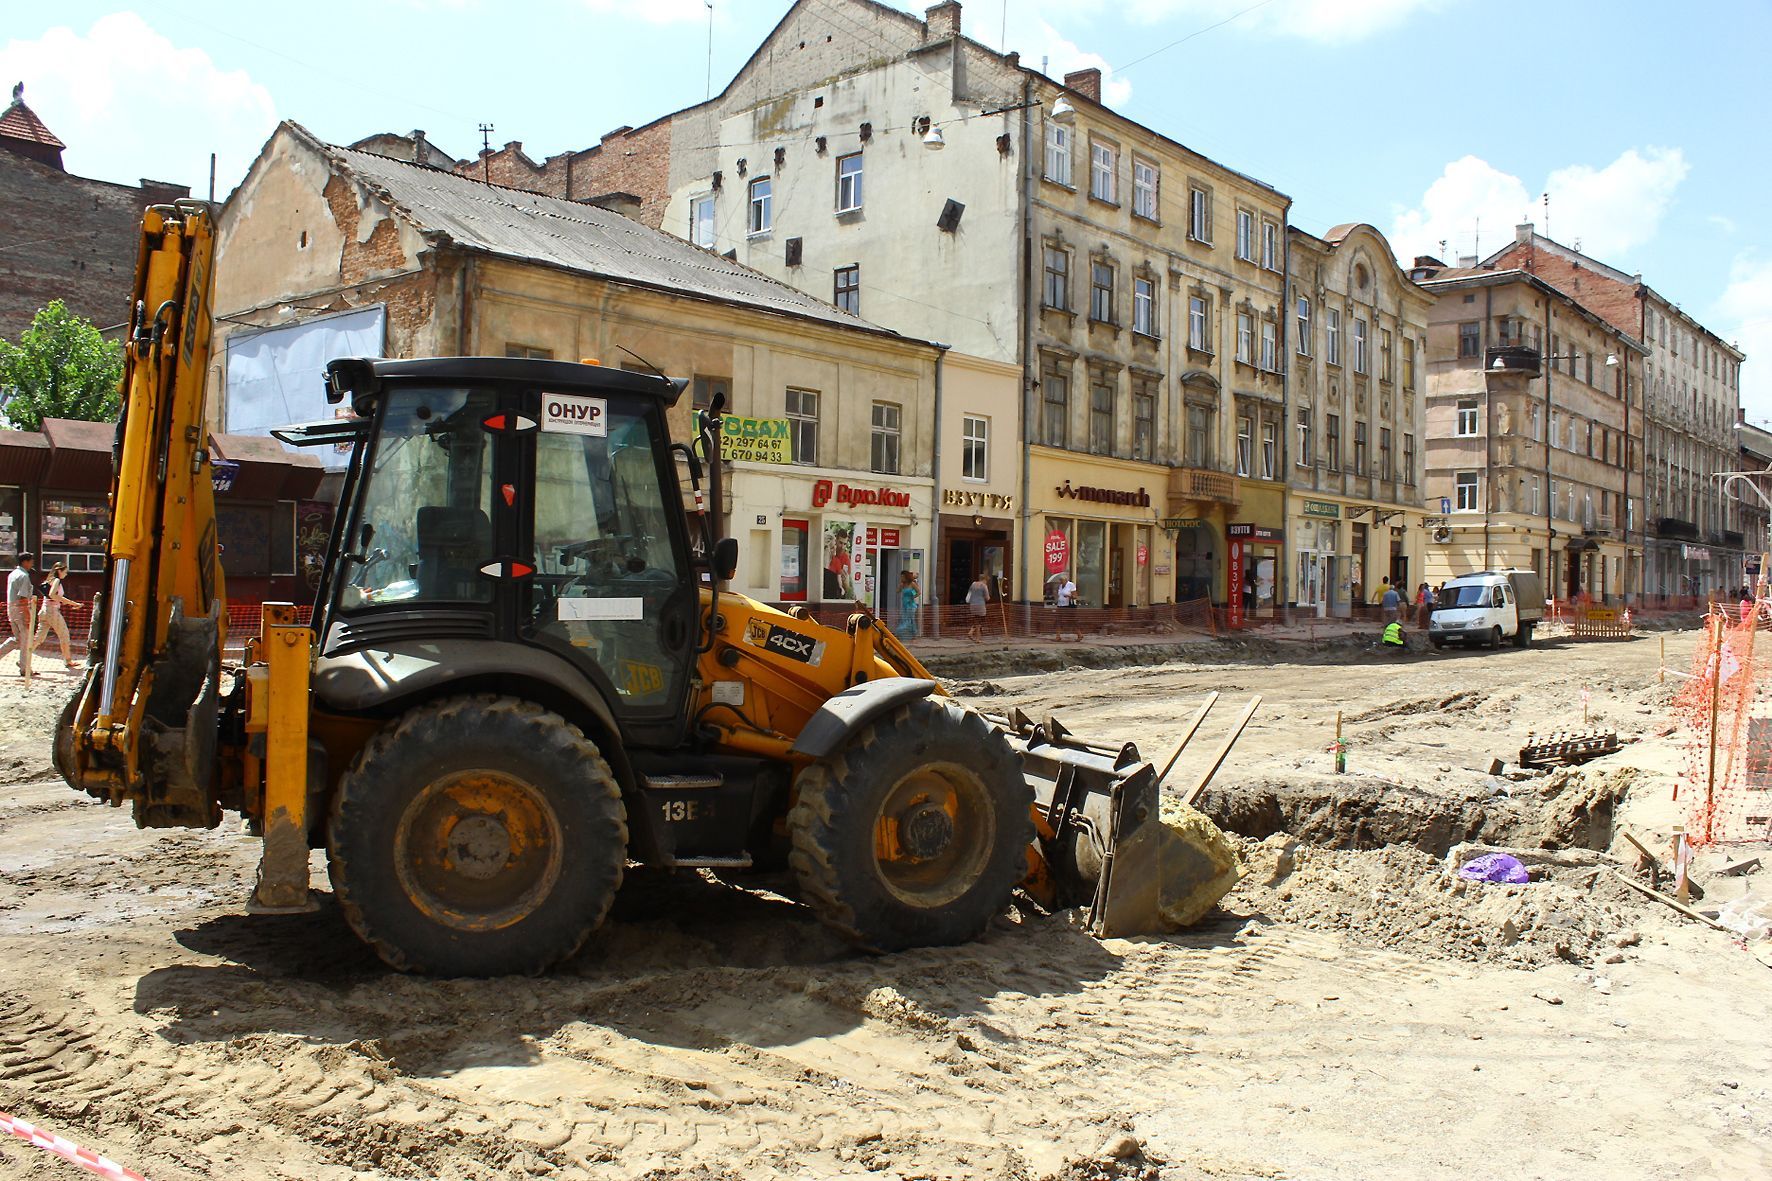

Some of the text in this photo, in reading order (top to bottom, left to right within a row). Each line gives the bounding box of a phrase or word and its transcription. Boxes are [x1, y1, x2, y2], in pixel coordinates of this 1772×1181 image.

[548, 402, 601, 420] ОНУР
[692, 413, 789, 439] ПОДАЖ
[736, 437, 755, 448] 297
[757, 439, 769, 449] 64
[771, 440, 782, 450] 67
[731, 449, 752, 460] 670
[755, 451, 768, 461] 94
[770, 452, 782, 462] 33
[944, 489, 1014, 511] ВЗУТТЯ
[1079, 486, 1150, 507] monarch
[1045, 541, 1066, 553] SALE
[1231, 561, 1239, 625] ВЗУТТЯ
[751, 625, 767, 640] JCB
[769, 634, 811, 656] 4CX
[627, 664, 661, 693] JCB
